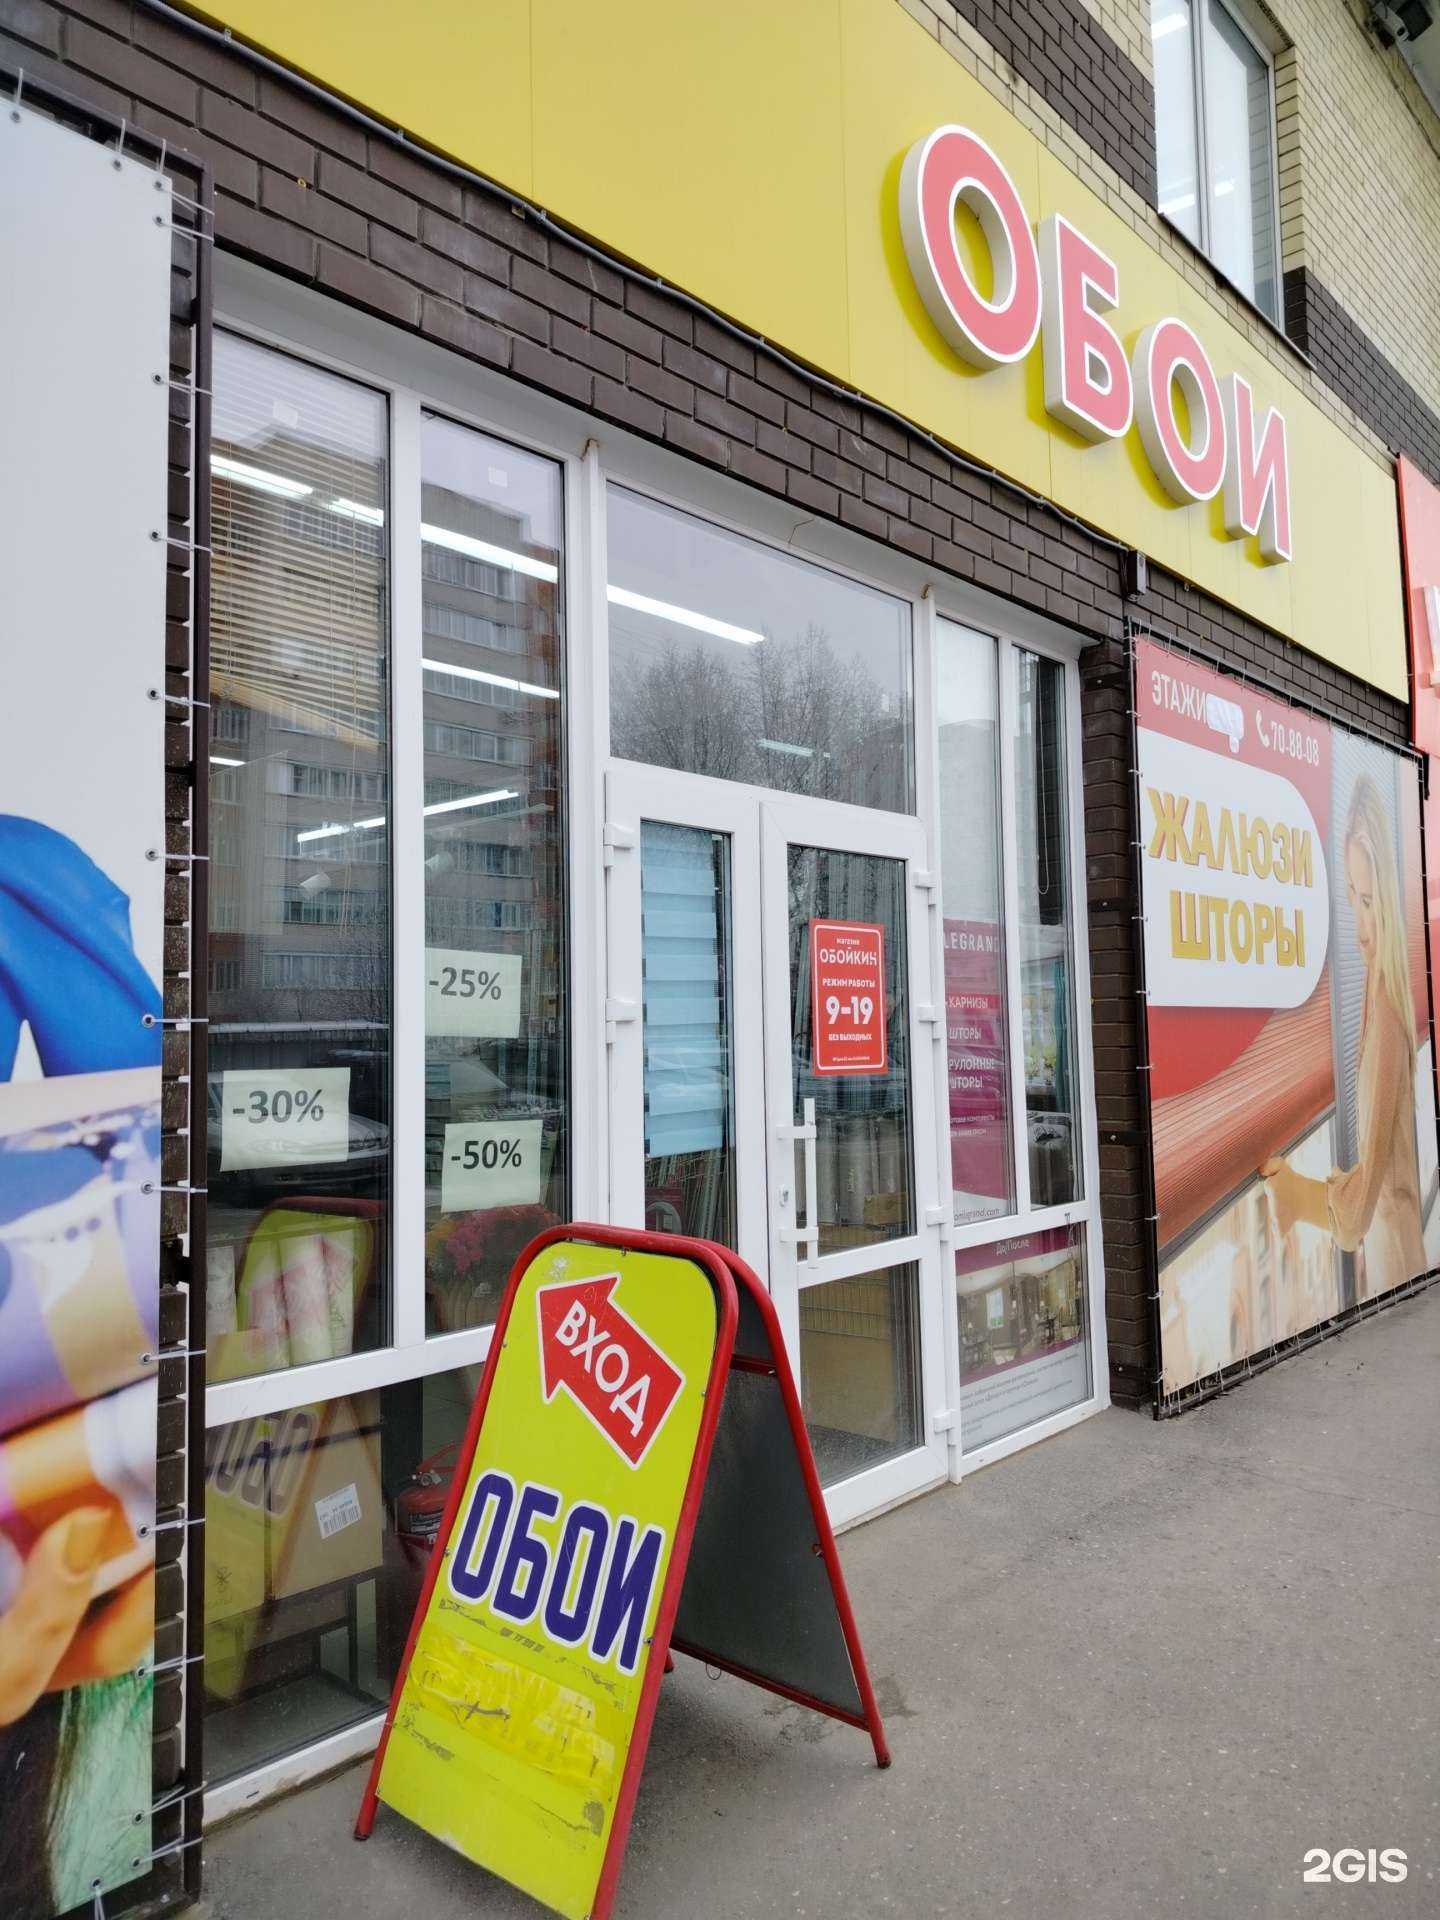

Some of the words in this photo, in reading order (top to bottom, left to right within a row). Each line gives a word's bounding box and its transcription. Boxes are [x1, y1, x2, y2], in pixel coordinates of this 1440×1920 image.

[900, 124, 1292, 564] ОБОИ
[1151, 671, 1207, 724] ЭТАЖИ
[1271, 720, 1320, 767] 70-88-08
[1146, 786, 1314, 889] ЖАЛЮЗИ
[1169, 889, 1307, 969] ШТОРЫ
[428, 966, 502, 1001] -25%
[822, 978, 848, 987] РЕЖИМ
[848, 978, 876, 988] РАБОТЫ
[825, 995, 874, 1025] 9-19
[949, 1027, 982, 1040] ШТОРЫ
[232, 1088, 325, 1124] -30%
[450, 1138, 522, 1170] -50%
[555, 1300, 644, 1438] ВХОД
[449, 1470, 664, 1674] ОБОИ
